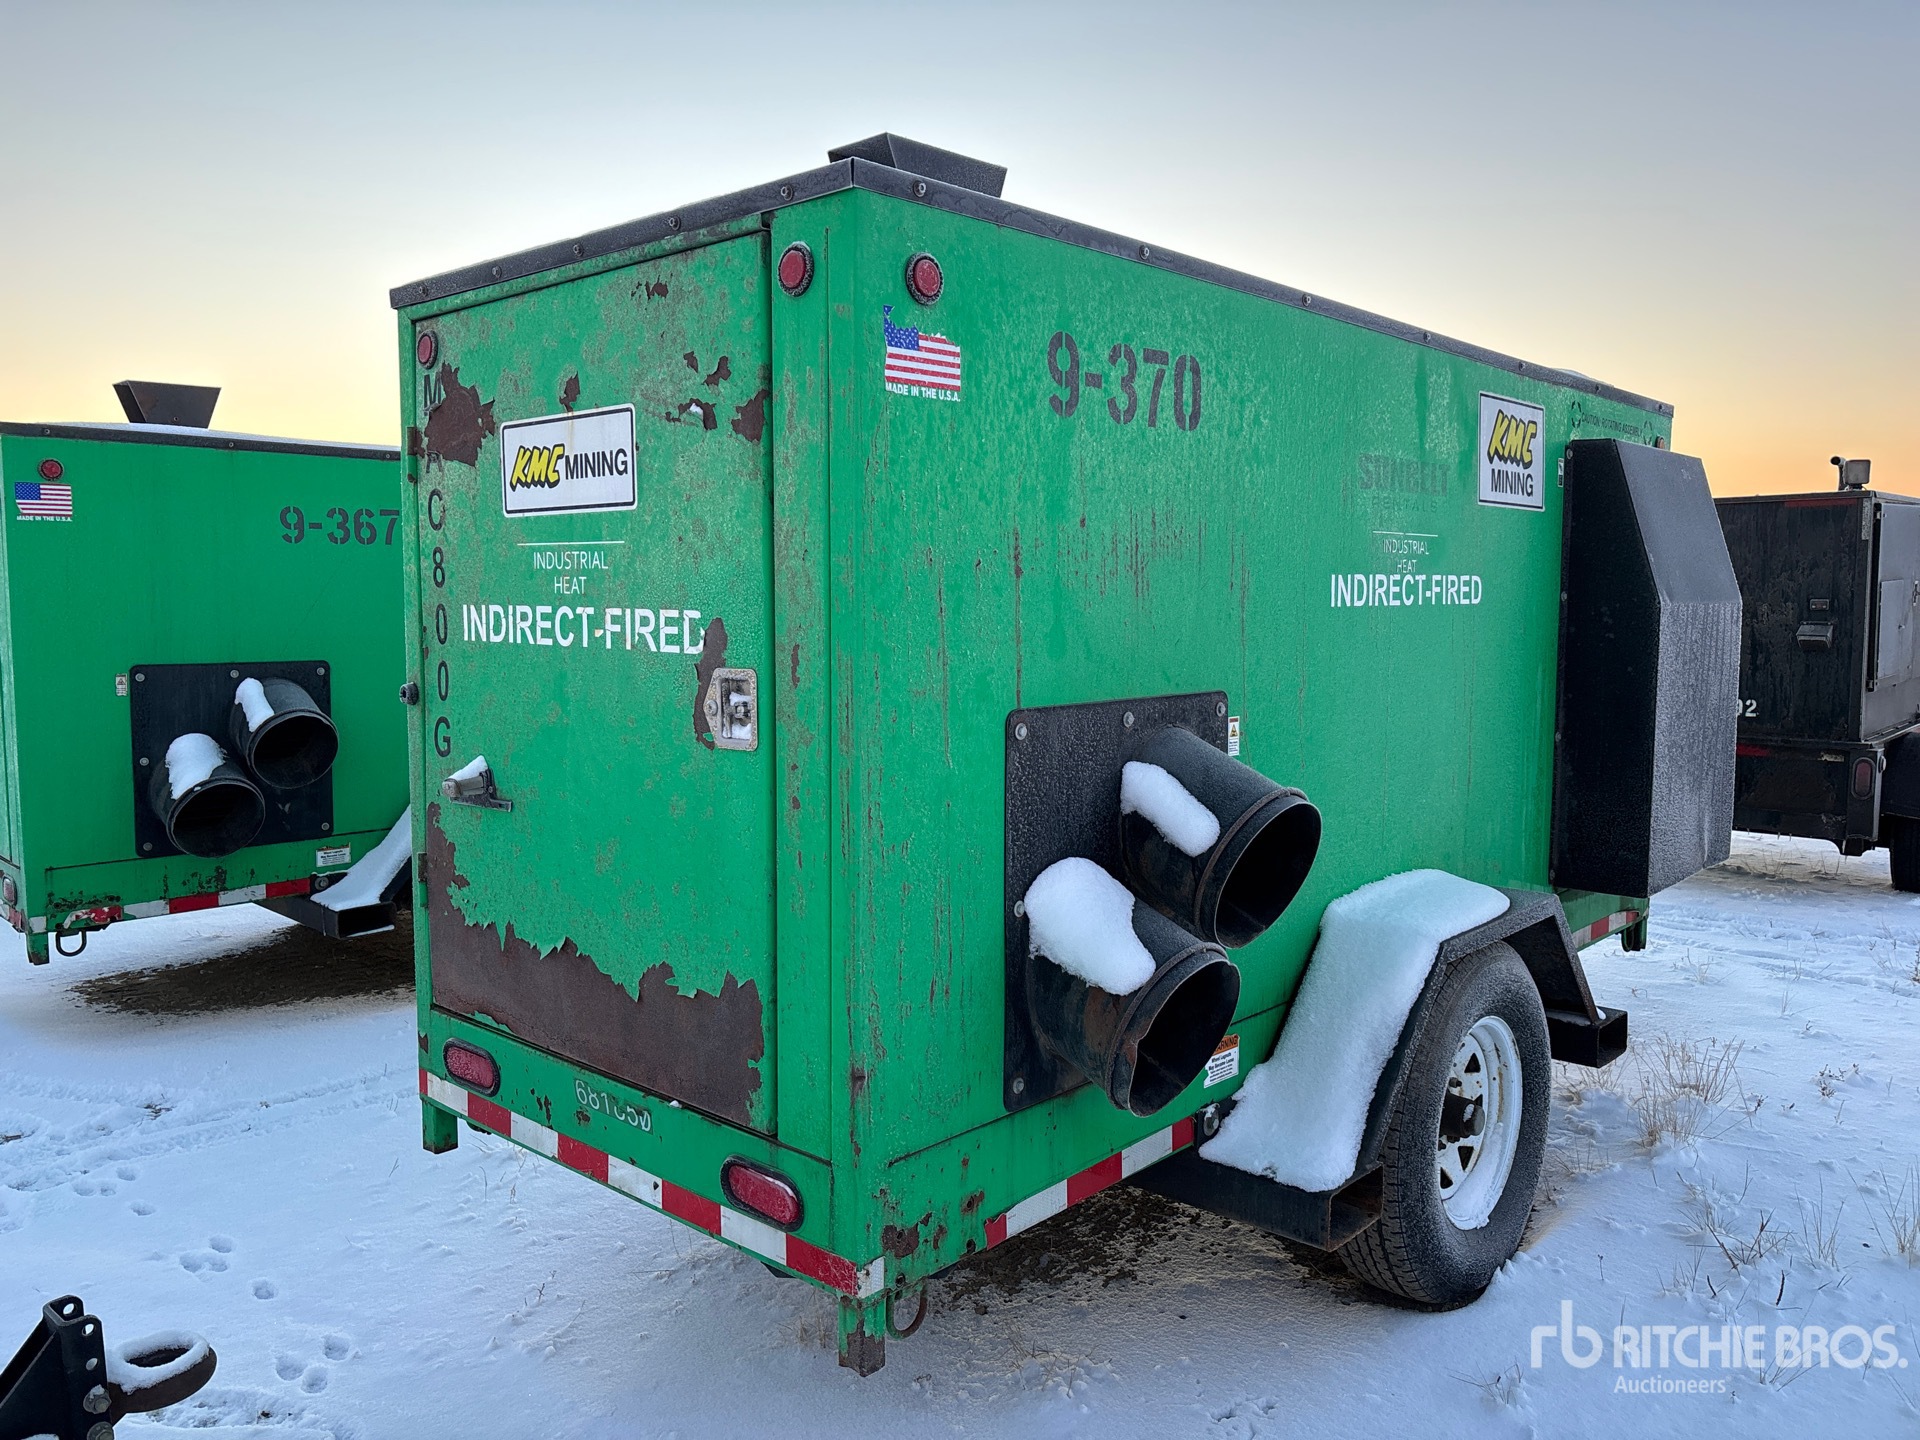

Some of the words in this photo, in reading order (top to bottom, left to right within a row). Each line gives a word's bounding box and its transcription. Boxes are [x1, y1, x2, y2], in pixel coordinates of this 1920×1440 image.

[886, 382, 909, 396] MADE
[911, 385, 919, 397] IN
[921, 387, 937, 399] THE
[939, 389, 961, 402] U.S.A.
[1047, 331, 1202, 431] 9-370
[1487, 408, 1537, 470] KMC
[510, 443, 565, 492] KMC
[564, 448, 628, 480] MINING
[1491, 468, 1534, 497] MINING
[279, 505, 400, 545] 9-367
[533, 551, 609, 570] INDUSTRIAL
[1383, 539, 1430, 555] INDUSTRIAL
[1397, 559, 1417, 574] HEAT
[554, 576, 587, 594] HEAT
[1330, 573, 1482, 607] INDIRECT-FIRED
[462, 604, 706, 655] INDIRECT-FIRED
